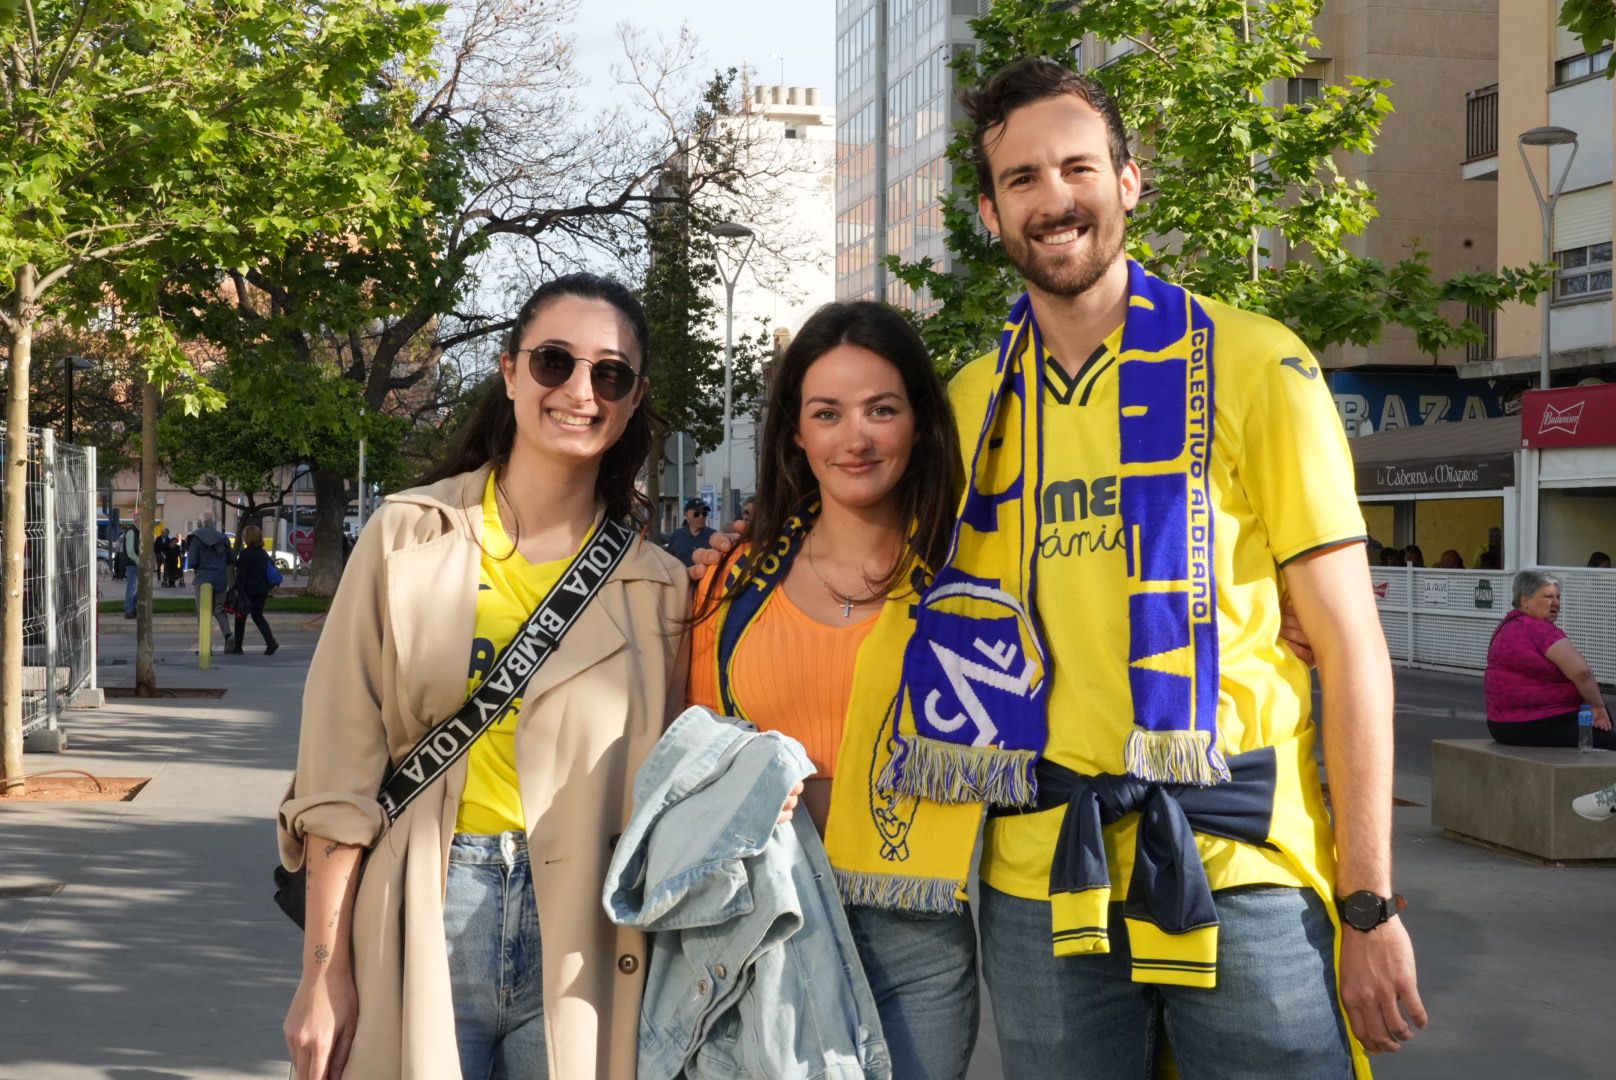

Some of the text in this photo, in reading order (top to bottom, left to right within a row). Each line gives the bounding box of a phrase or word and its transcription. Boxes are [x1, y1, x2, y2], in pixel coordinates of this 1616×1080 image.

[1334, 393, 1503, 438] BAZA
[1543, 411, 1580, 426] Budweiser
[562, 532, 621, 597] LOLA
[1191, 488, 1208, 619] ALDEANO
[473, 697, 500, 723] Y
[402, 718, 474, 784] LOLA
